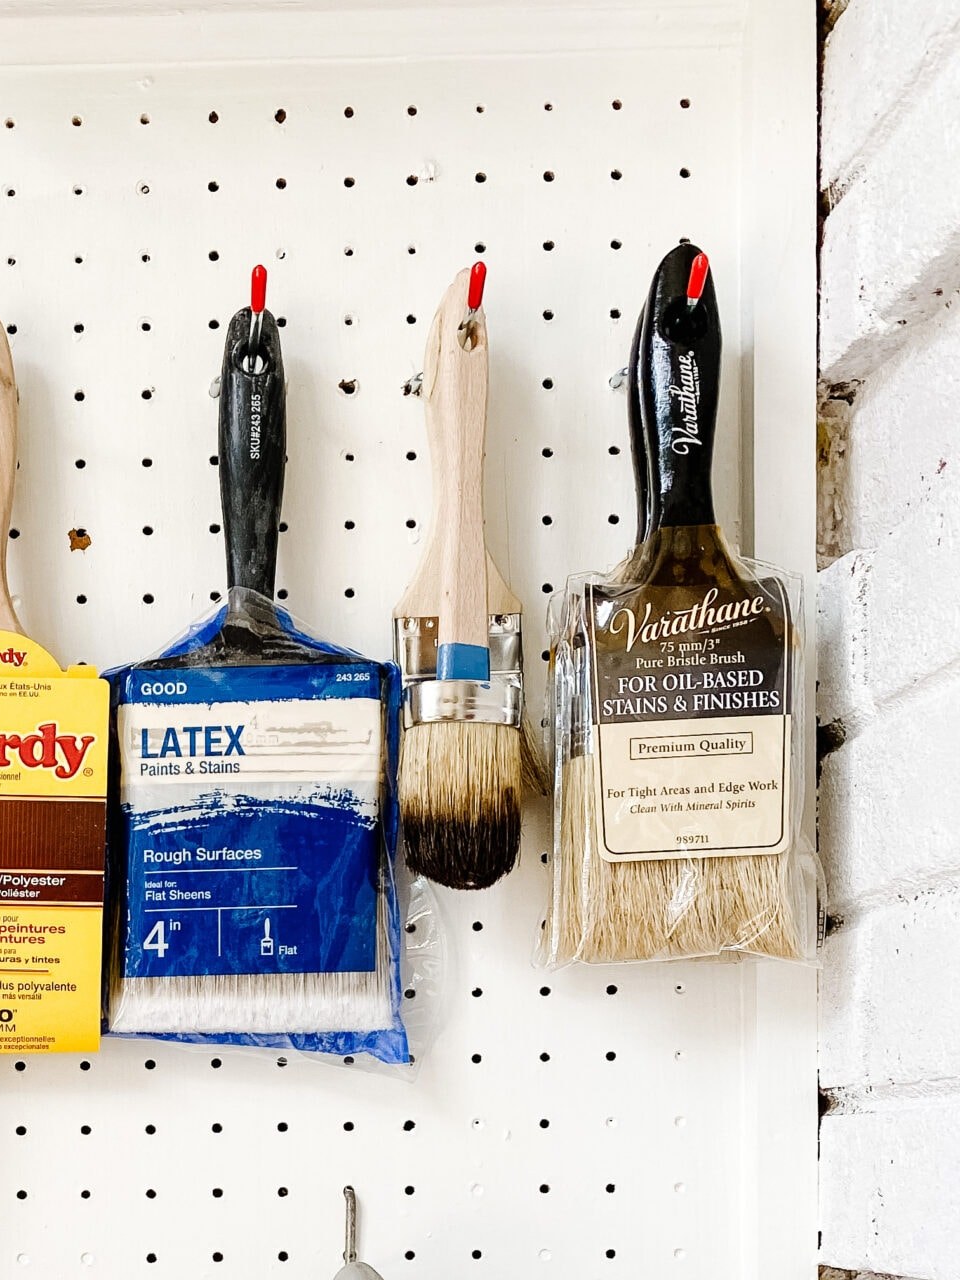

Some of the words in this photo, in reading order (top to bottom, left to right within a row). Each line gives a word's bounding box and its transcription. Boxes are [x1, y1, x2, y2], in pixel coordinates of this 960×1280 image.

[251, 394, 260, 412] 265
[669, 355, 702, 455] Varathane
[251, 415, 260, 459] SKU#243
[610, 588, 763, 653] Varathane
[660, 641, 674, 653] 75
[636, 657, 664, 669] Pure
[667, 654, 707, 667] Bristle
[710, 653, 745, 665] Brush
[336, 674, 352, 682] 243
[354, 672, 370, 681] 265
[618, 676, 656, 694] FOR
[663, 669, 764, 691] OIL-BASED
[10, 681, 51, 690] États-Unis
[140, 683, 187, 695] GOOD
[603, 696, 668, 716] STAINS
[674, 695, 687, 711] &
[693, 691, 780, 710] FINISHES
[141, 725, 246, 759] LATEX
[638, 741, 695, 754] Premium
[699, 738, 747, 752] Quality
[140, 762, 181, 776] Paints
[184, 762, 194, 774] &
[199, 761, 240, 775] Stains
[607, 788, 625, 799] For
[627, 786, 657, 800] Tight
[660, 785, 691, 795] Areas
[694, 782, 715, 794] and
[718, 782, 745, 795] Edge
[748, 780, 778, 792] Work
[630, 804, 657, 814] Clean
[660, 802, 683, 812] With
[686, 800, 723, 811] Mineral
[726, 799, 756, 811] Spirits
[676, 835, 709, 844] 989711
[144, 849, 192, 865] Rough
[196, 847, 262, 861] Surfaces
[145, 881, 162, 889] Ideal
[164, 881, 177, 889] for:
[145, 890, 167, 901] Flat
[169, 889, 211, 900] Sheens
[3, 915, 18, 923] pour
[143, 920, 169, 958] 4
[170, 919, 181, 931] in
[278, 945, 297, 955] Flat
[32, 956, 60, 964] tintes
[17, 981, 77, 992] polyvalente
[0, 1035, 55, 1043] exceptionnelles
